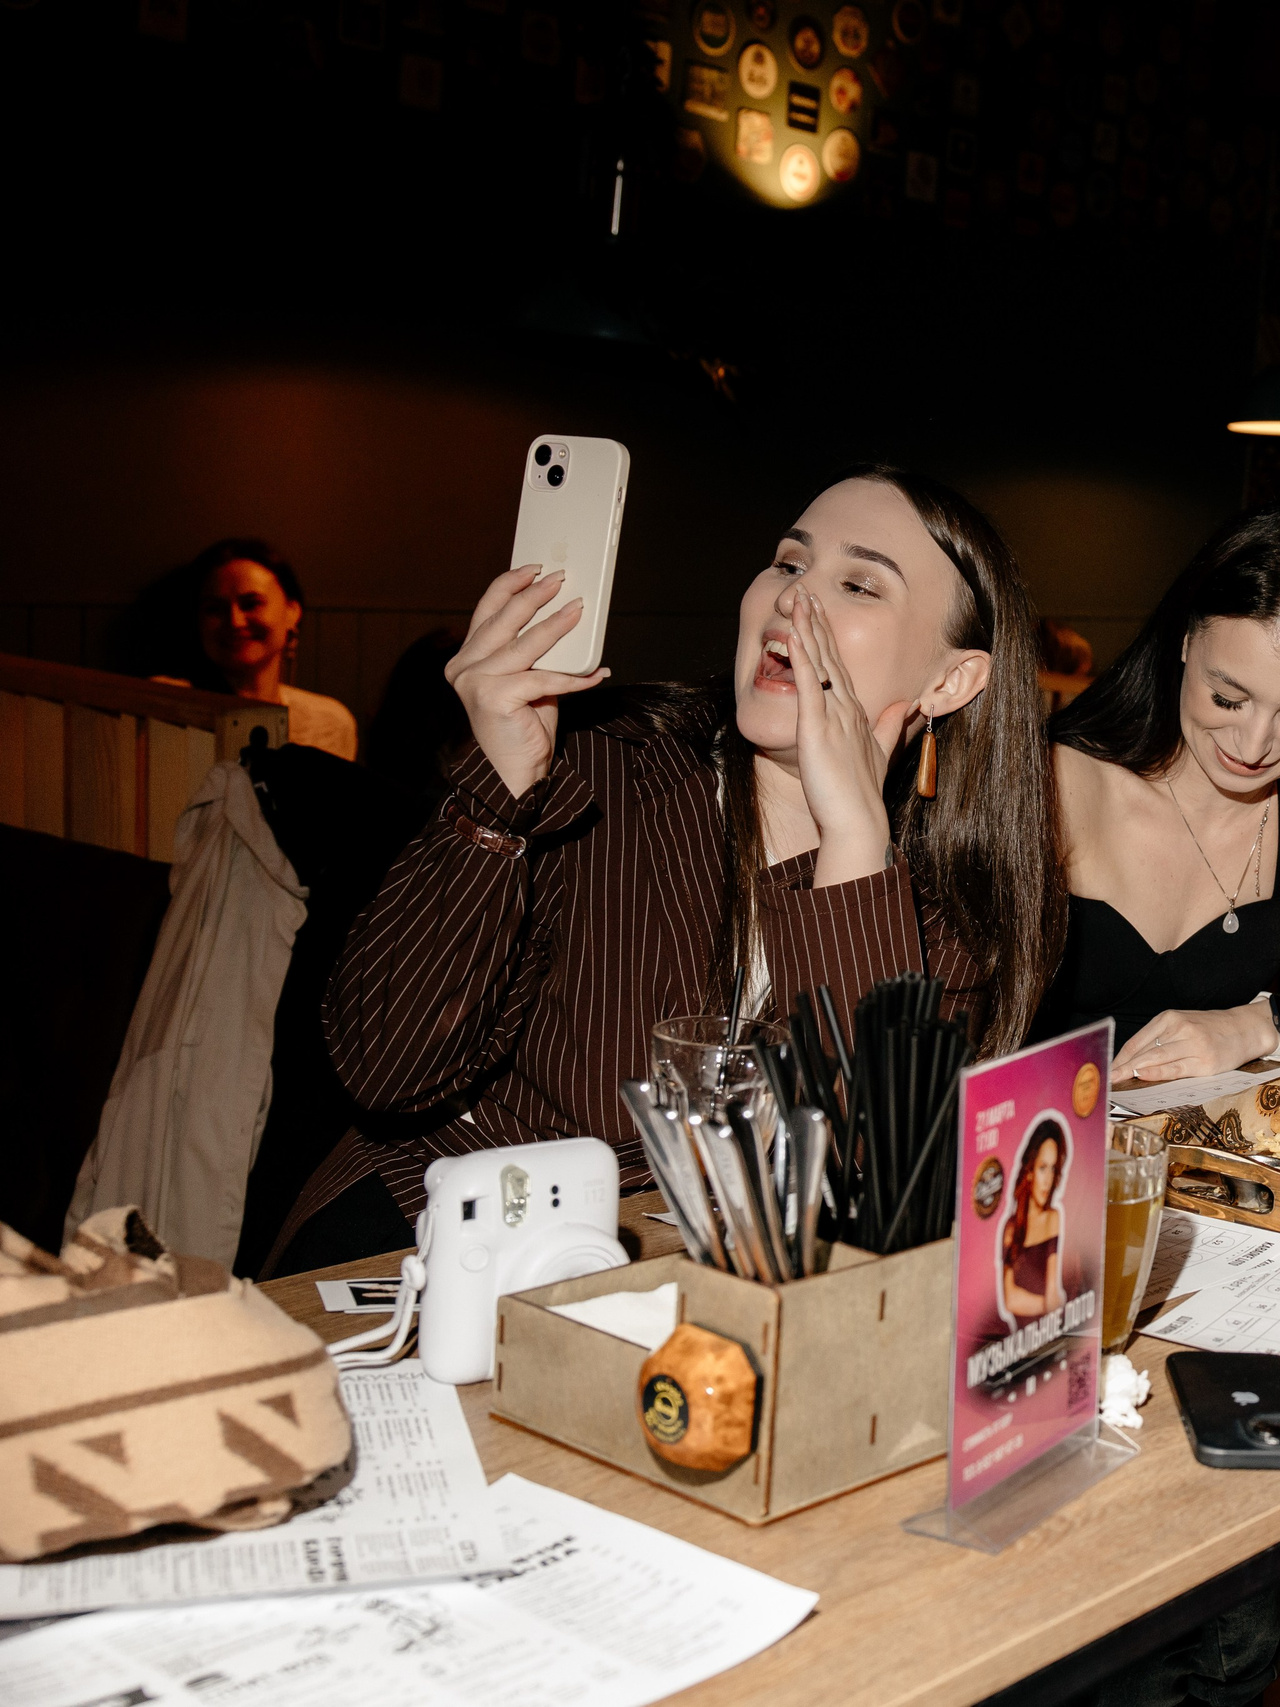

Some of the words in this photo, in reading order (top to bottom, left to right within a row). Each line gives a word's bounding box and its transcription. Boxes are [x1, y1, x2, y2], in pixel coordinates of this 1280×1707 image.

[967, 1310, 1063, 1390] МУЗЫКАЛЬНОЕ
[1062, 1289, 1096, 1334] ЛОТО
[339, 1371, 427, 1382] АКУСКИ
